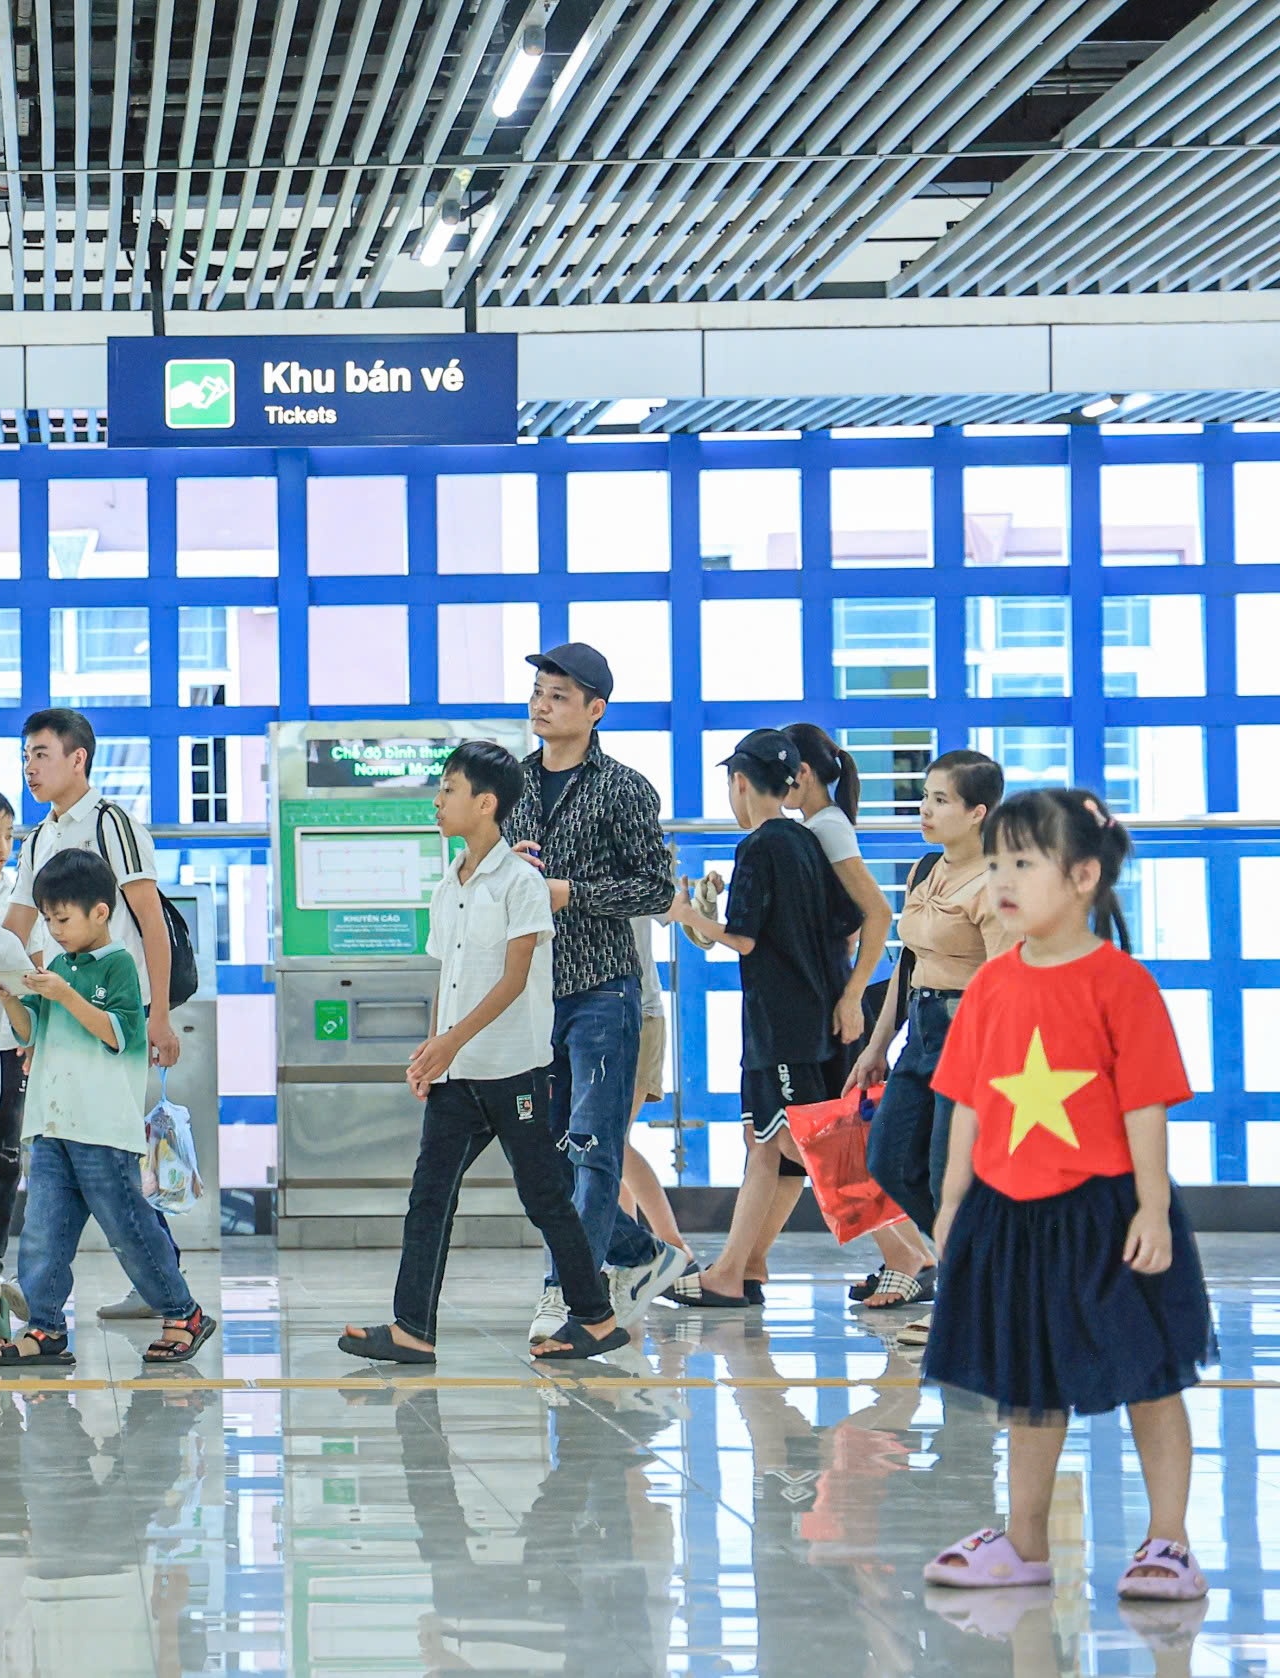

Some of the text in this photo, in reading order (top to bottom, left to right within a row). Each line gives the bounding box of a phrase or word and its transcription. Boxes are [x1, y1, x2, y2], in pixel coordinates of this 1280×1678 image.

[263, 358, 465, 394] Khu bán vé
[264, 405, 337, 424] Tickets
[384, 744, 417, 760] bình
[354, 762, 406, 776] Normal
